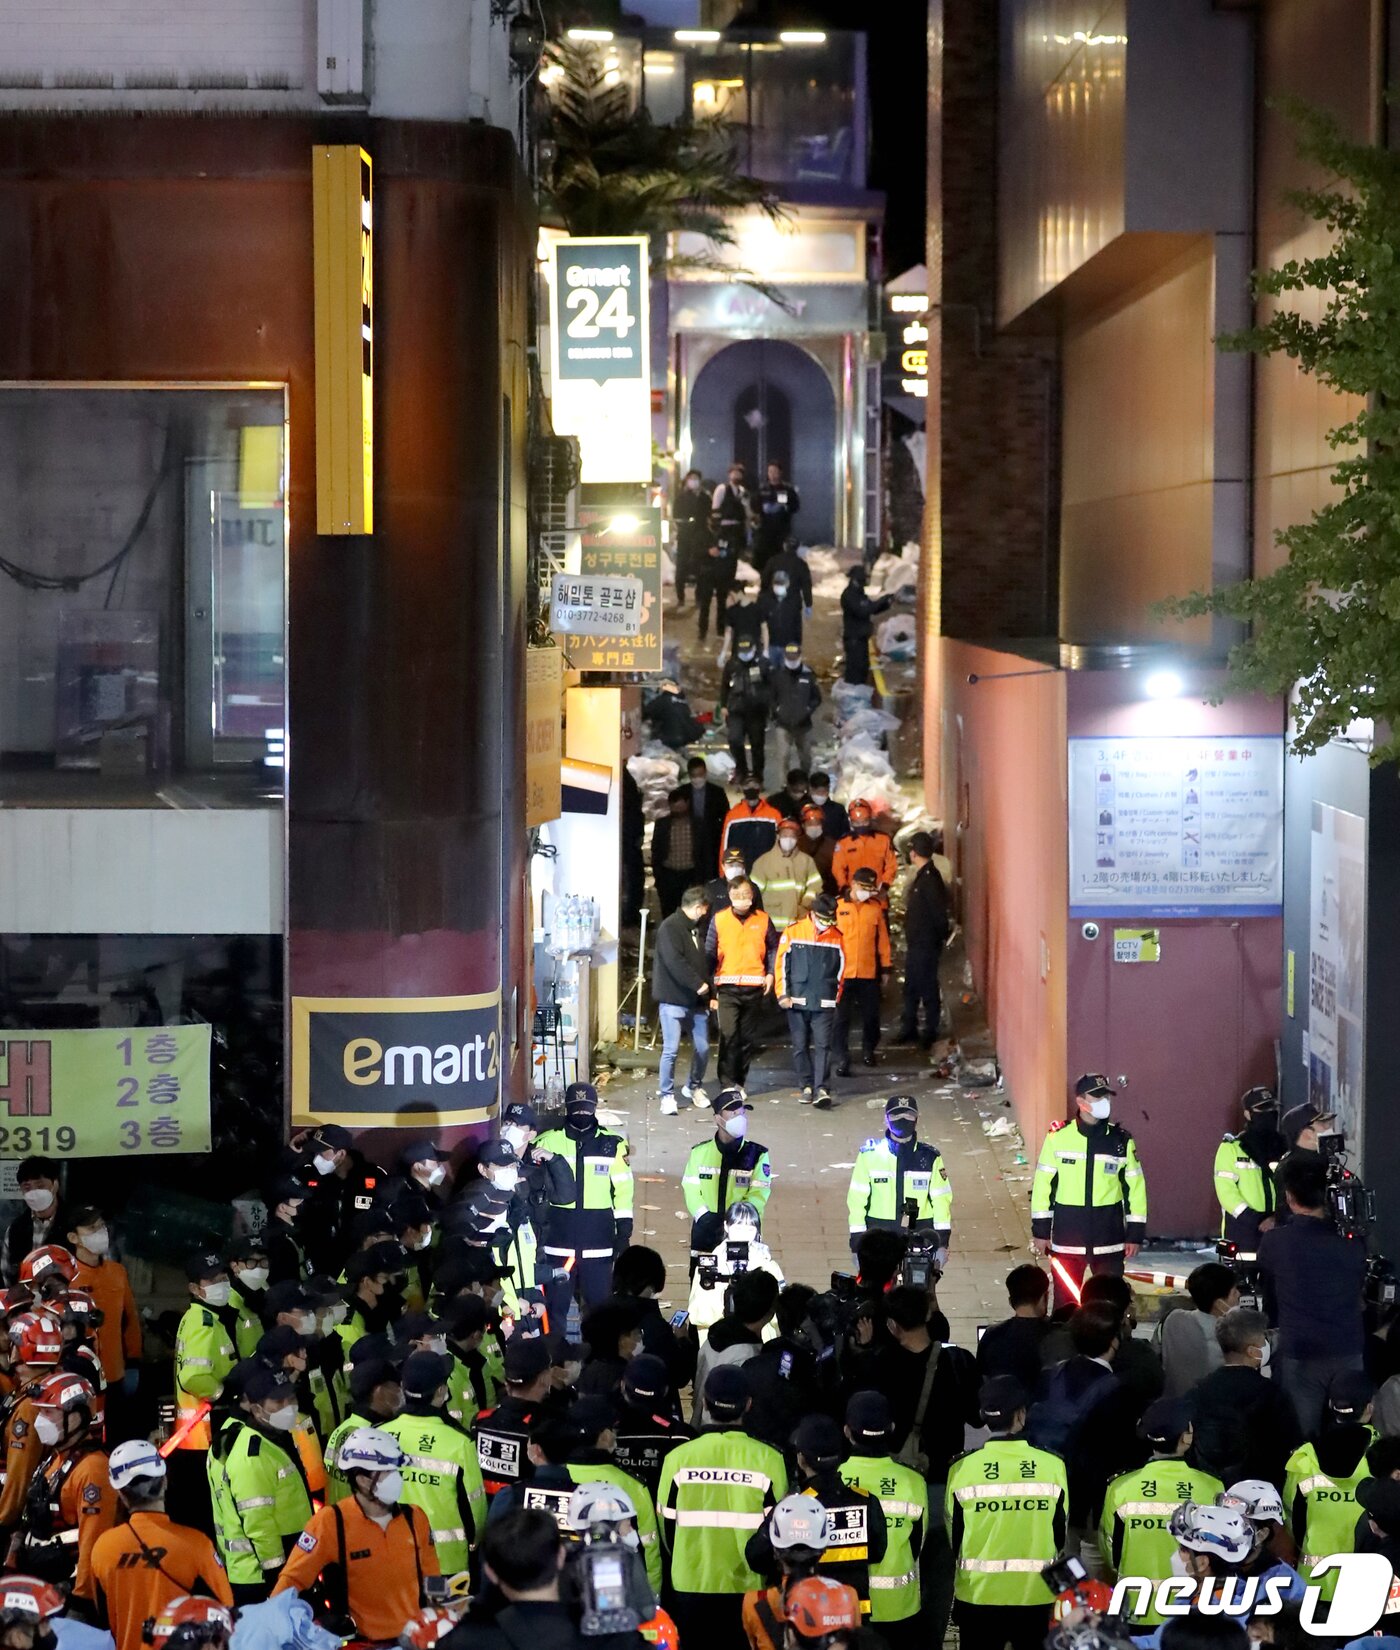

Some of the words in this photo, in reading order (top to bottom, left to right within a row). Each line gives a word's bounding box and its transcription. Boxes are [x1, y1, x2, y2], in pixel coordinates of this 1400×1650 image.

[566, 287, 636, 339] 24
[557, 584, 594, 607] 해밀톤
[600, 587, 637, 610] 골프샵
[556, 610, 625, 624] 010-3772-4268
[1116, 941, 1139, 950] CCTV
[116, 1034, 179, 1066] 1층
[116, 1073, 181, 1108] 2층
[119, 1116, 183, 1150] 3층
[480, 1438, 516, 1461] 경찰
[401, 1470, 441, 1487] LICE
[687, 1470, 753, 1484] POLICE
[983, 1460, 1037, 1480] 경찰
[1140, 1480, 1194, 1500] 경찰
[1317, 1490, 1356, 1503] POL
[974, 1499, 1049, 1512] POLICE
[1130, 1518, 1168, 1530] POL
[829, 1530, 862, 1542] OLICE
